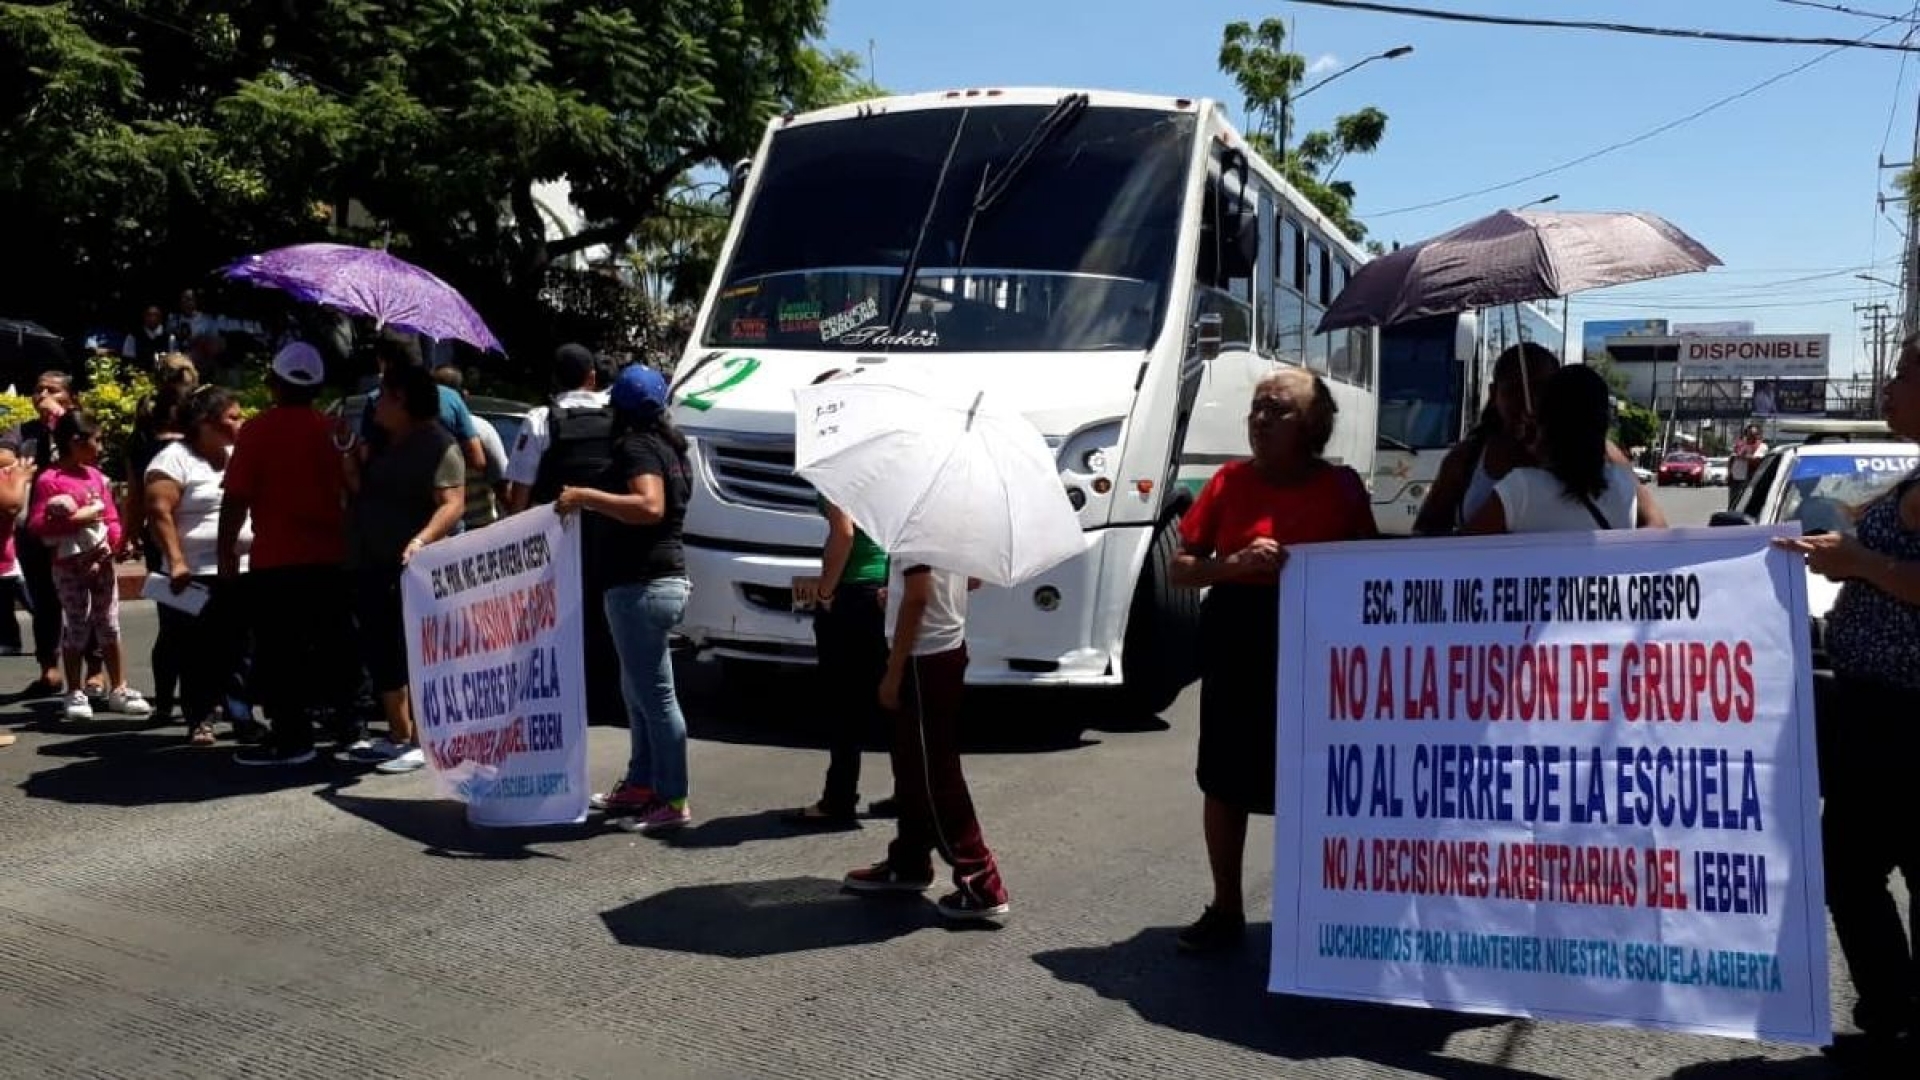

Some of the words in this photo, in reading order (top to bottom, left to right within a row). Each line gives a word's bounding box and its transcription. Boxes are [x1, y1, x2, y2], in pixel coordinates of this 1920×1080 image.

[1690, 341, 1820, 360] DISPONIBLE
[680, 357, 761, 412] 2
[1363, 580, 1397, 625] ESC.
[1402, 579, 1447, 624] PRIM.
[1453, 578, 1489, 623] ING.
[1493, 577, 1551, 622] FELIPE
[1557, 575, 1622, 622] RIVERA
[1628, 573, 1700, 621] CRESPO
[421, 613, 439, 667] NO
[442, 610, 452, 662] A
[454, 605, 472, 659] LA
[423, 677, 440, 729] NO
[443, 674, 462, 724] AL
[462, 666, 505, 721] CIERRE
[1329, 645, 1369, 721] NO
[1374, 646, 1395, 721] A
[1404, 645, 1440, 721] LA
[1447, 624, 1560, 722] FUSIÓN
[1570, 643, 1610, 721] DE
[1620, 641, 1755, 724] GRUPOS
[528, 713, 564, 752] IEBEM
[1326, 743, 1363, 818] NO
[1369, 743, 1403, 819] AL
[1412, 743, 1513, 822] CIERRE
[1523, 745, 1561, 823] DE
[1570, 746, 1608, 825] LA
[1616, 746, 1763, 832] ESCUELA
[1322, 837, 1348, 891] NO
[1354, 838, 1367, 891] A
[1372, 839, 1490, 899] DECISIONES
[1496, 842, 1638, 908] ARBITRARIAS
[1645, 848, 1687, 910] DEL
[1694, 850, 1768, 915] IEBEM
[1318, 924, 1413, 961] LUCHAREMOS
[1416, 930, 1454, 965] PARA
[1457, 931, 1542, 974] MANTENER
[1546, 937, 1621, 979] NUESTRA
[1625, 943, 1700, 985] ESCUELA
[1705, 949, 1782, 991] ABIERTA
